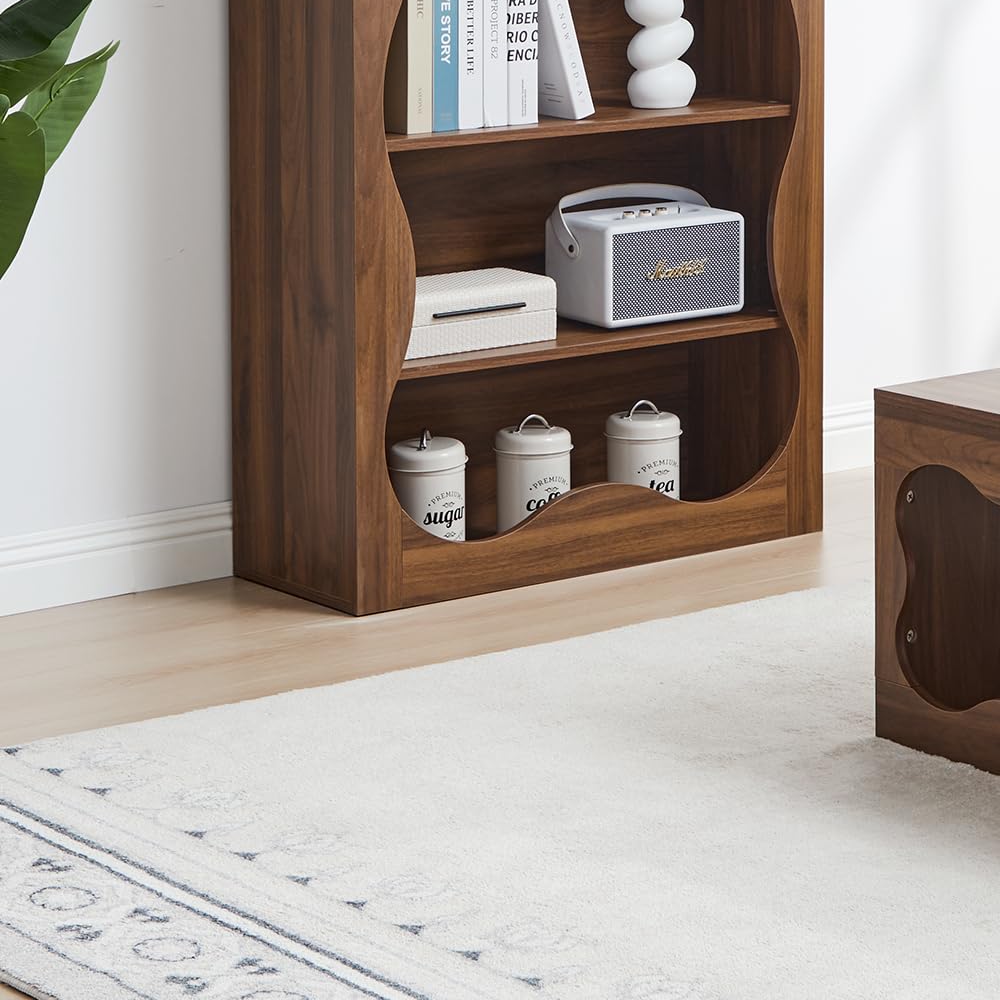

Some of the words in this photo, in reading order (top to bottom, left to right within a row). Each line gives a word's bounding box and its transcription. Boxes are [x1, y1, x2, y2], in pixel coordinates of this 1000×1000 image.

[466, 0, 474, 45] BETTER
[440, 15, 451, 65] STORY
[490, 45, 498, 59] 82
[507, 48, 538, 62] ENCI
[466, 49, 474, 76] LIFE
[641, 458, 678, 473] PREMIUM
[532, 475, 567, 490] PREMIUM
[650, 479, 675, 494] tea
[430, 490, 462, 505] PREMIUM
[423, 505, 464, 529] sugar
